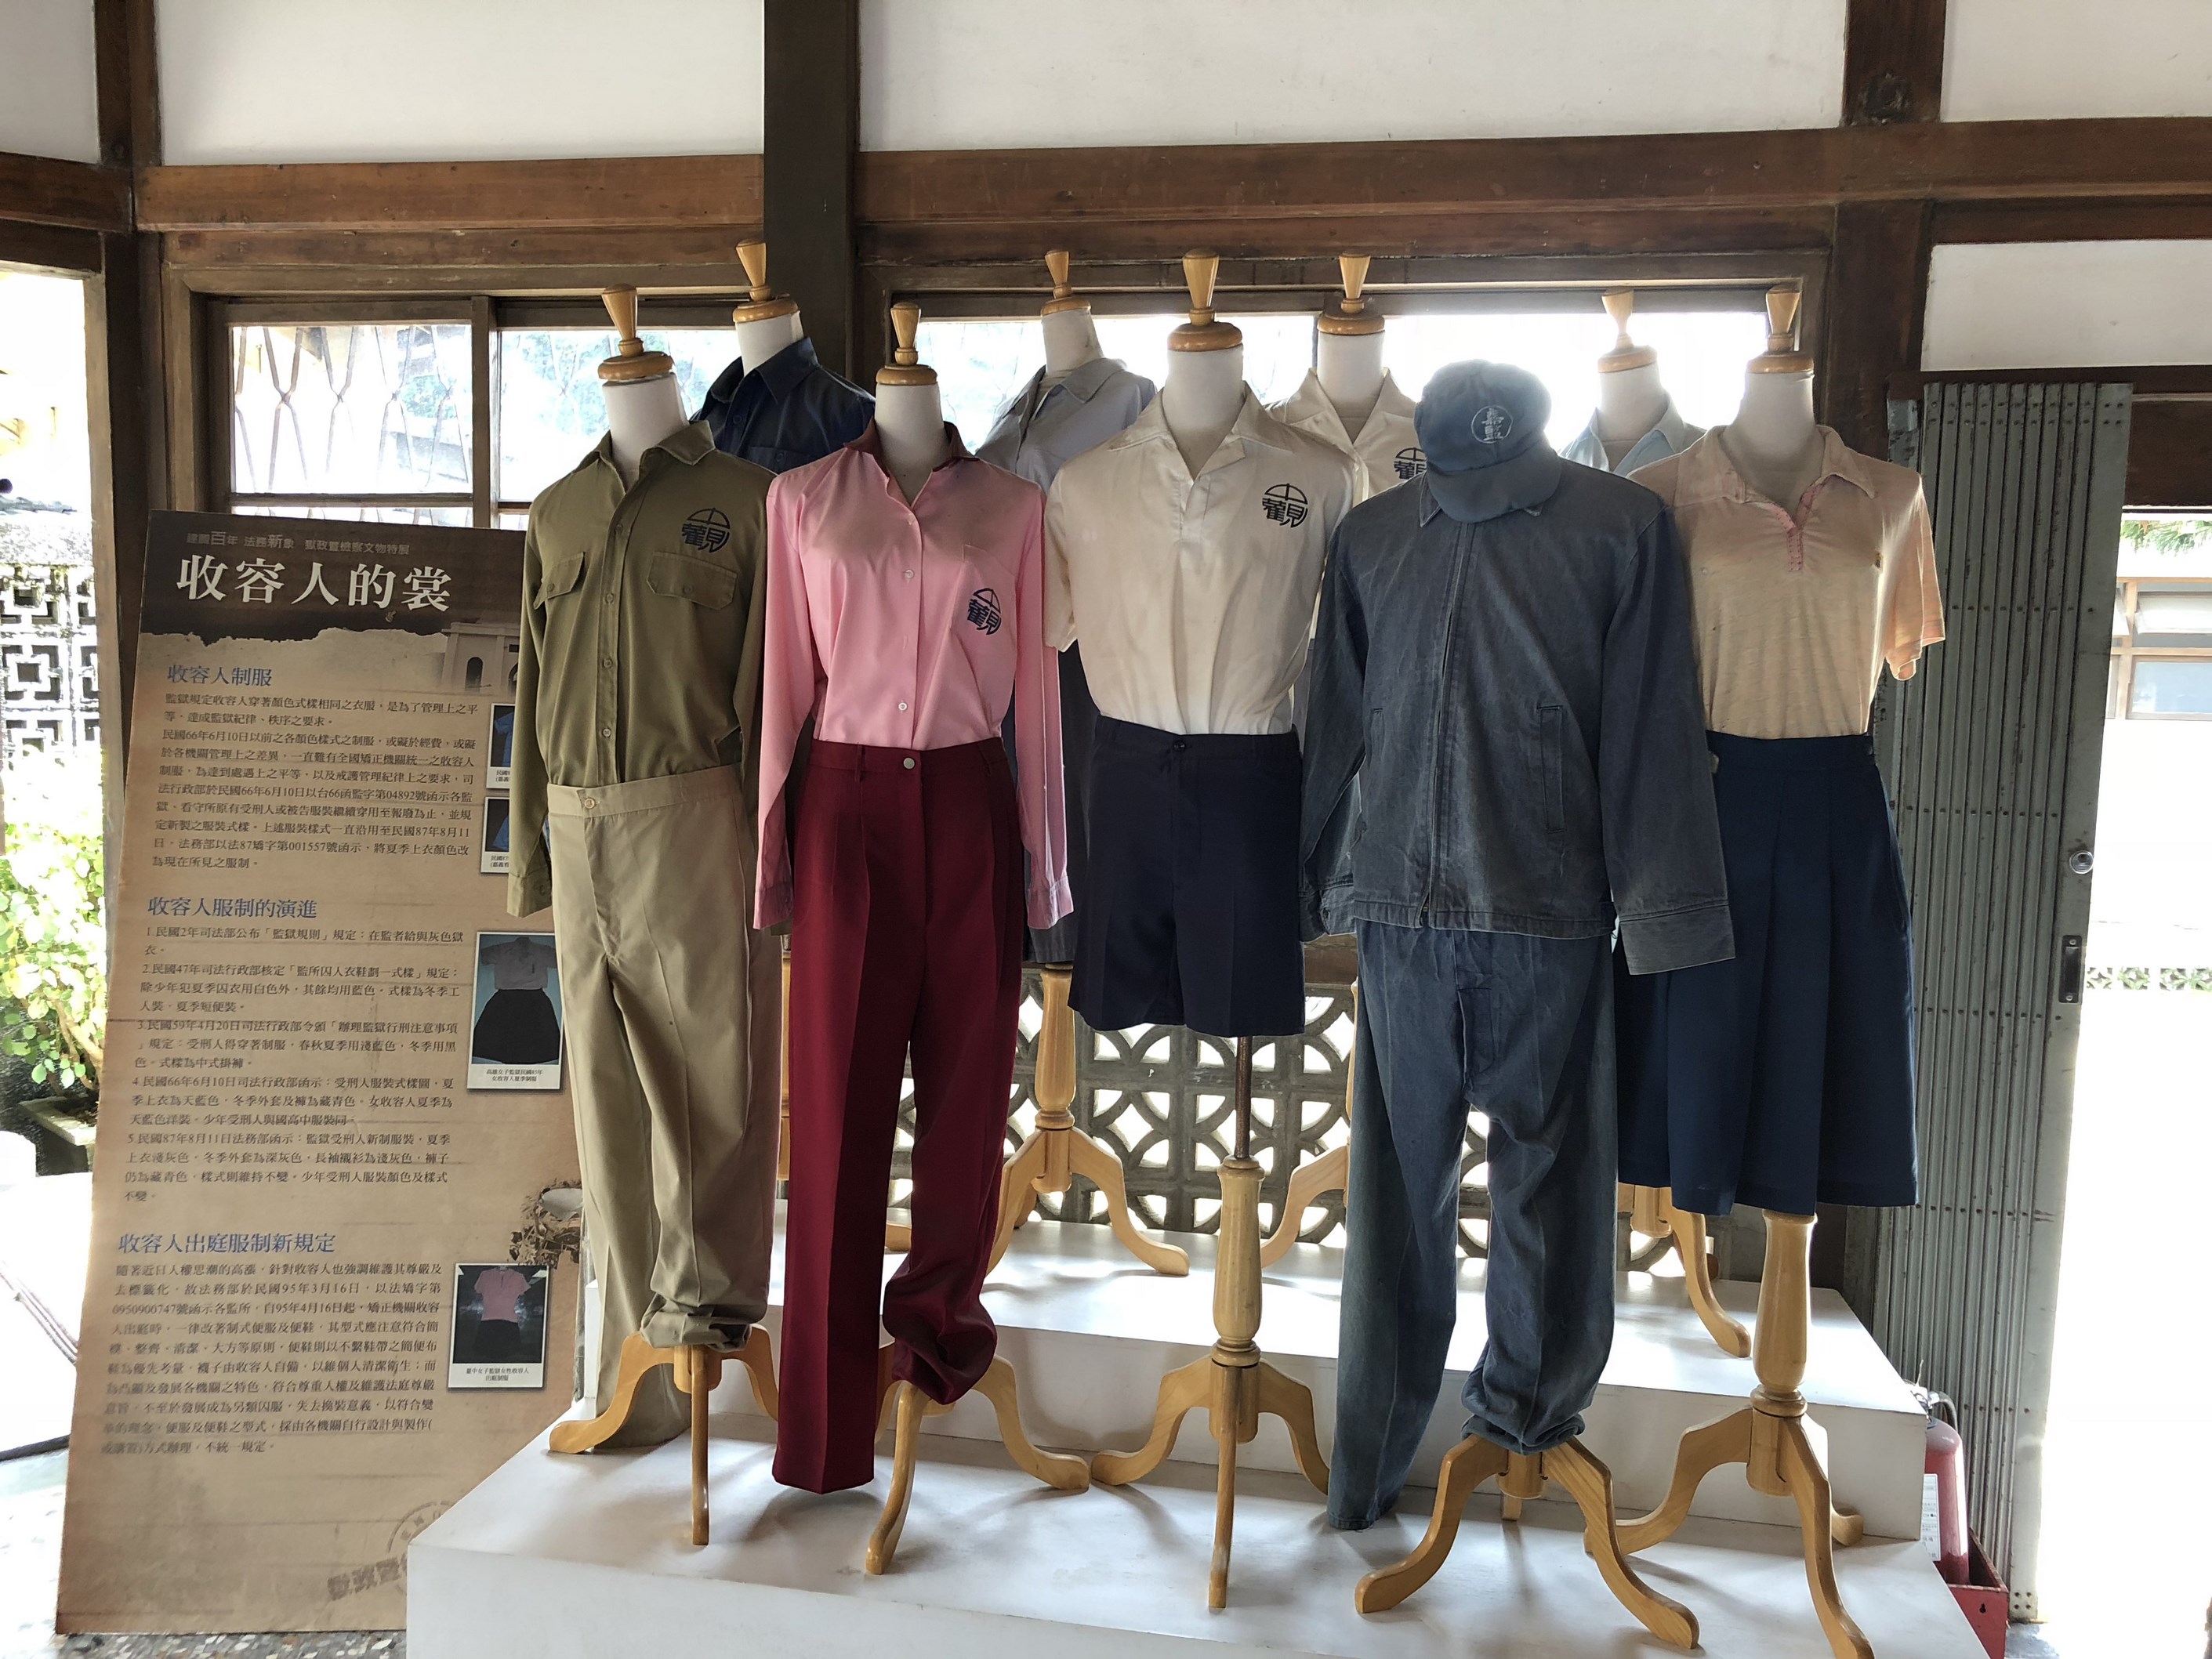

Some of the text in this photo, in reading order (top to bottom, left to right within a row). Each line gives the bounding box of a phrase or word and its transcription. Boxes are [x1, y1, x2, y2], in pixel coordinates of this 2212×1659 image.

[176, 553, 452, 613] 收容人的裳
[167, 663, 273, 687] 收容人制服
[147, 897, 317, 919] 收容人服制的演進
[118, 1233, 336, 1254] 收容人出庭服制新規定
